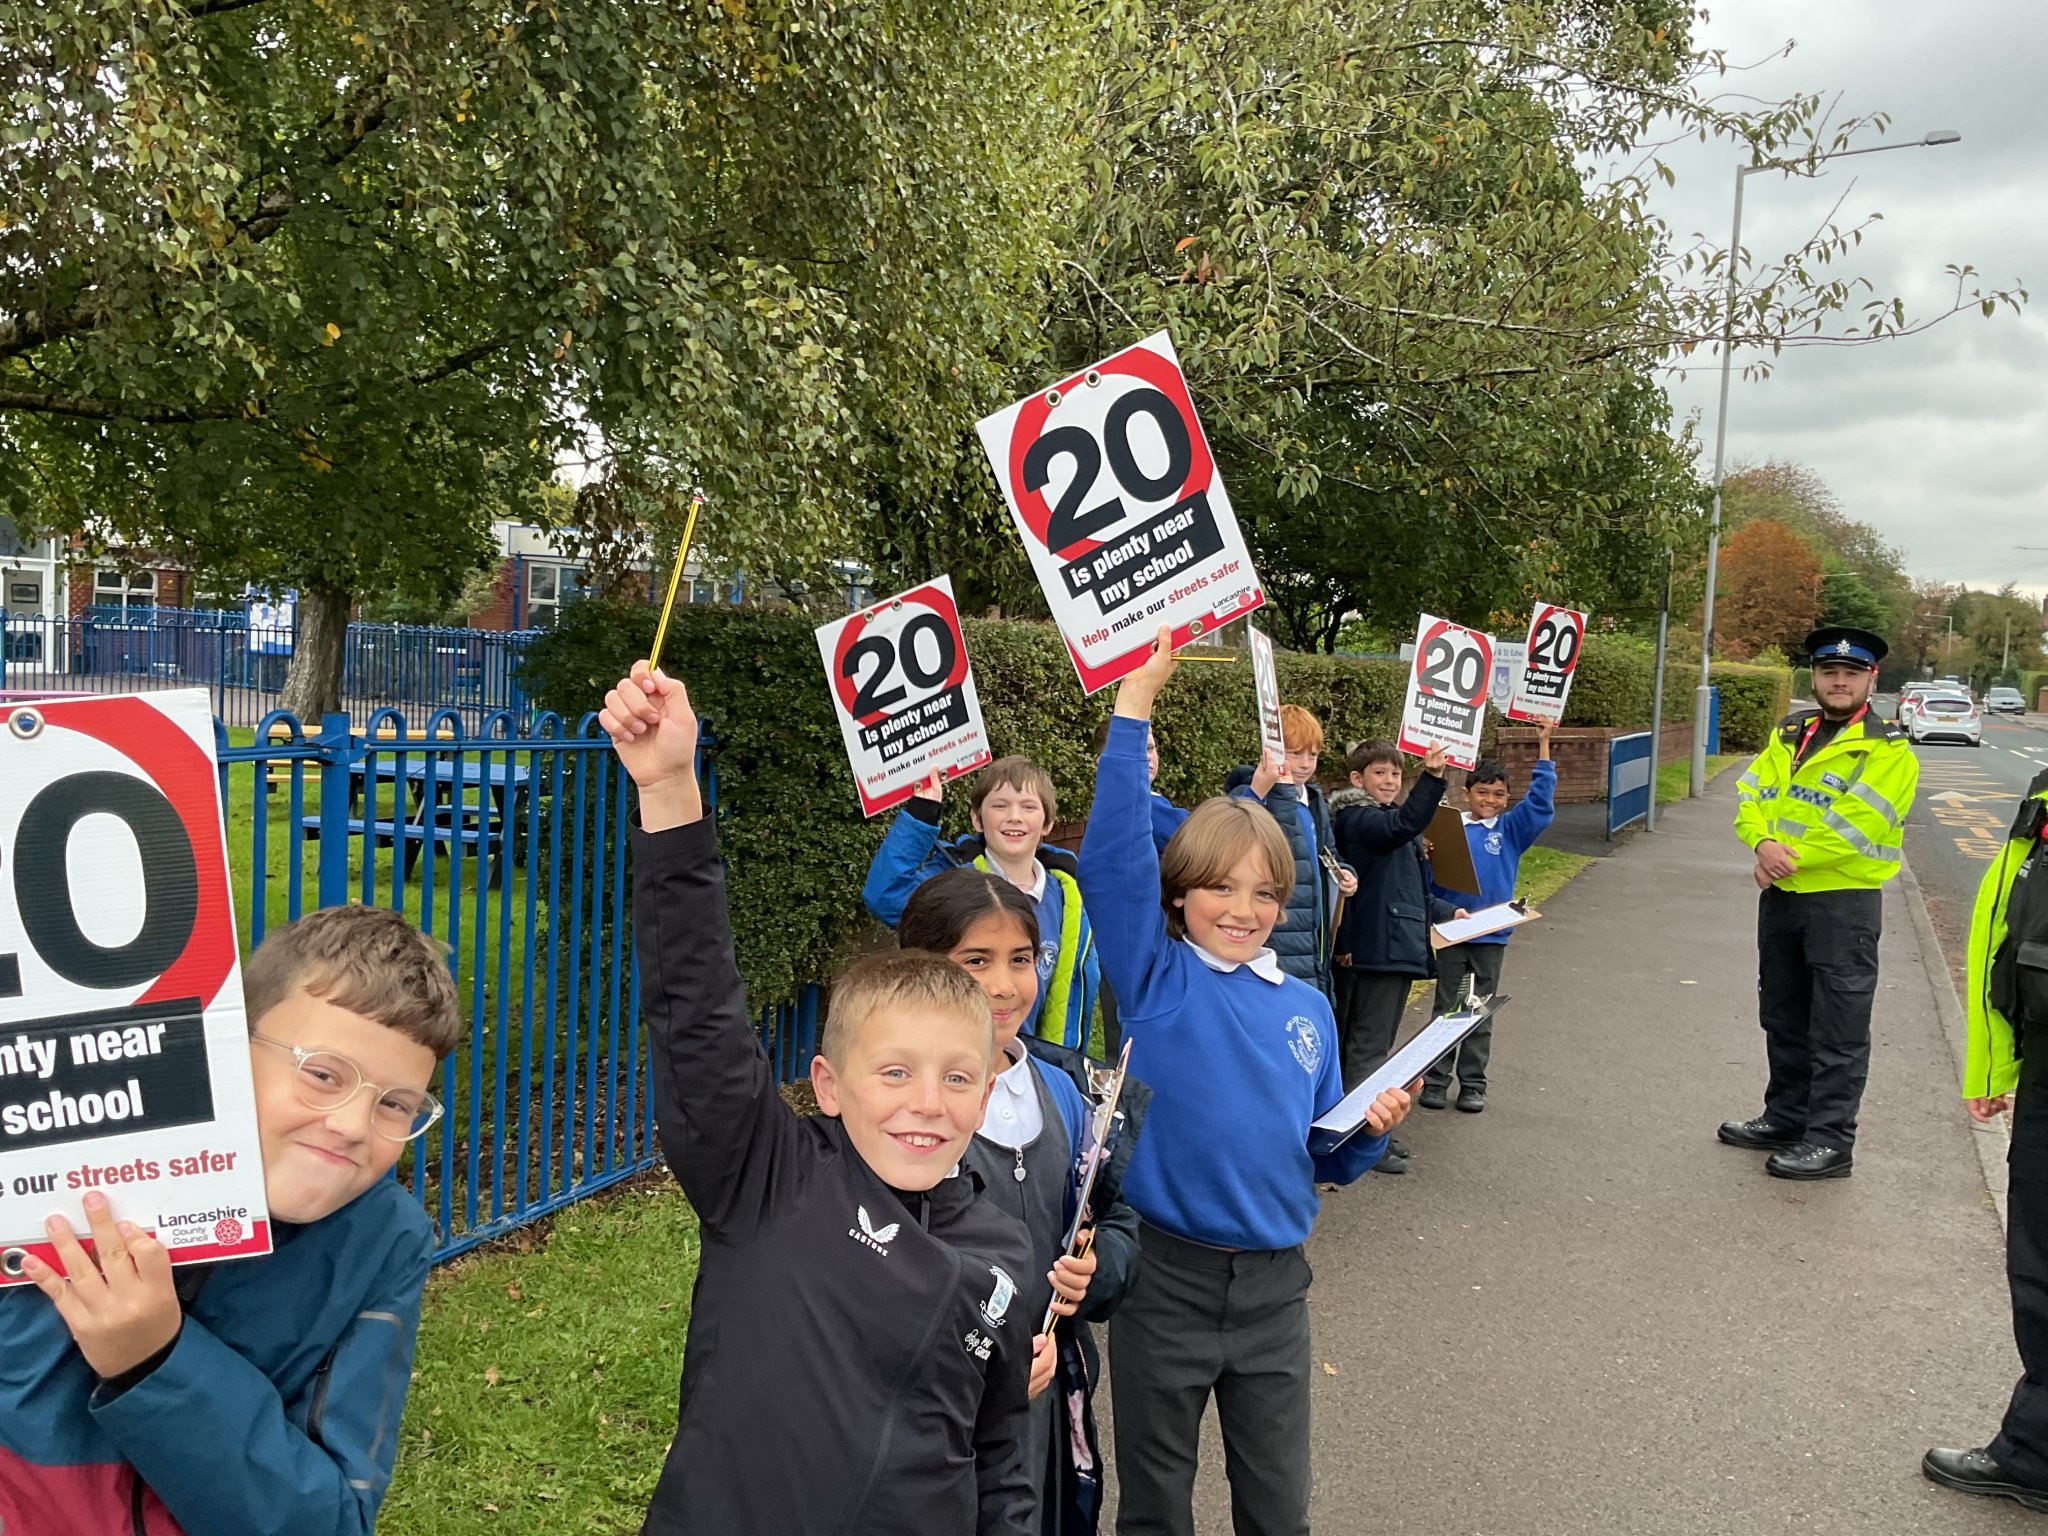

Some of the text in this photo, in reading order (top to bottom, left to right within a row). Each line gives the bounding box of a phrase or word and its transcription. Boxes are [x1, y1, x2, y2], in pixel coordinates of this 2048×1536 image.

[1022, 387, 1192, 556] 20
[1069, 507, 1195, 588] is plenty near
[1100, 539, 1195, 606] my school
[1081, 559, 1240, 648] Help make our streets safer
[1212, 585, 1251, 609] Lancashire
[842, 613, 956, 720] 20
[1417, 637, 1486, 700] 20
[1528, 620, 1578, 669] 20
[880, 708, 920, 740] plenty
[922, 693, 952, 717] near
[1418, 694, 1471, 717] is plenty near
[1423, 712, 1463, 730] my school
[867, 771, 886, 785] Help
[888, 761, 911, 776] make
[912, 754, 926, 765] our
[928, 740, 956, 758] streets
[957, 730, 979, 745] safer
[883, 714, 949, 758] my school
[0, 770, 199, 997] 0
[70, 1020, 166, 1065] near
[2, 1080, 144, 1135] school
[13, 1172, 59, 1196] our
[66, 1160, 161, 1190] streets
[169, 1148, 238, 1178] safer
[158, 1206, 248, 1228] Lancashire
[172, 1227, 207, 1237] County
[172, 1234, 209, 1246] Council
[848, 1228, 889, 1257] CASTORE
